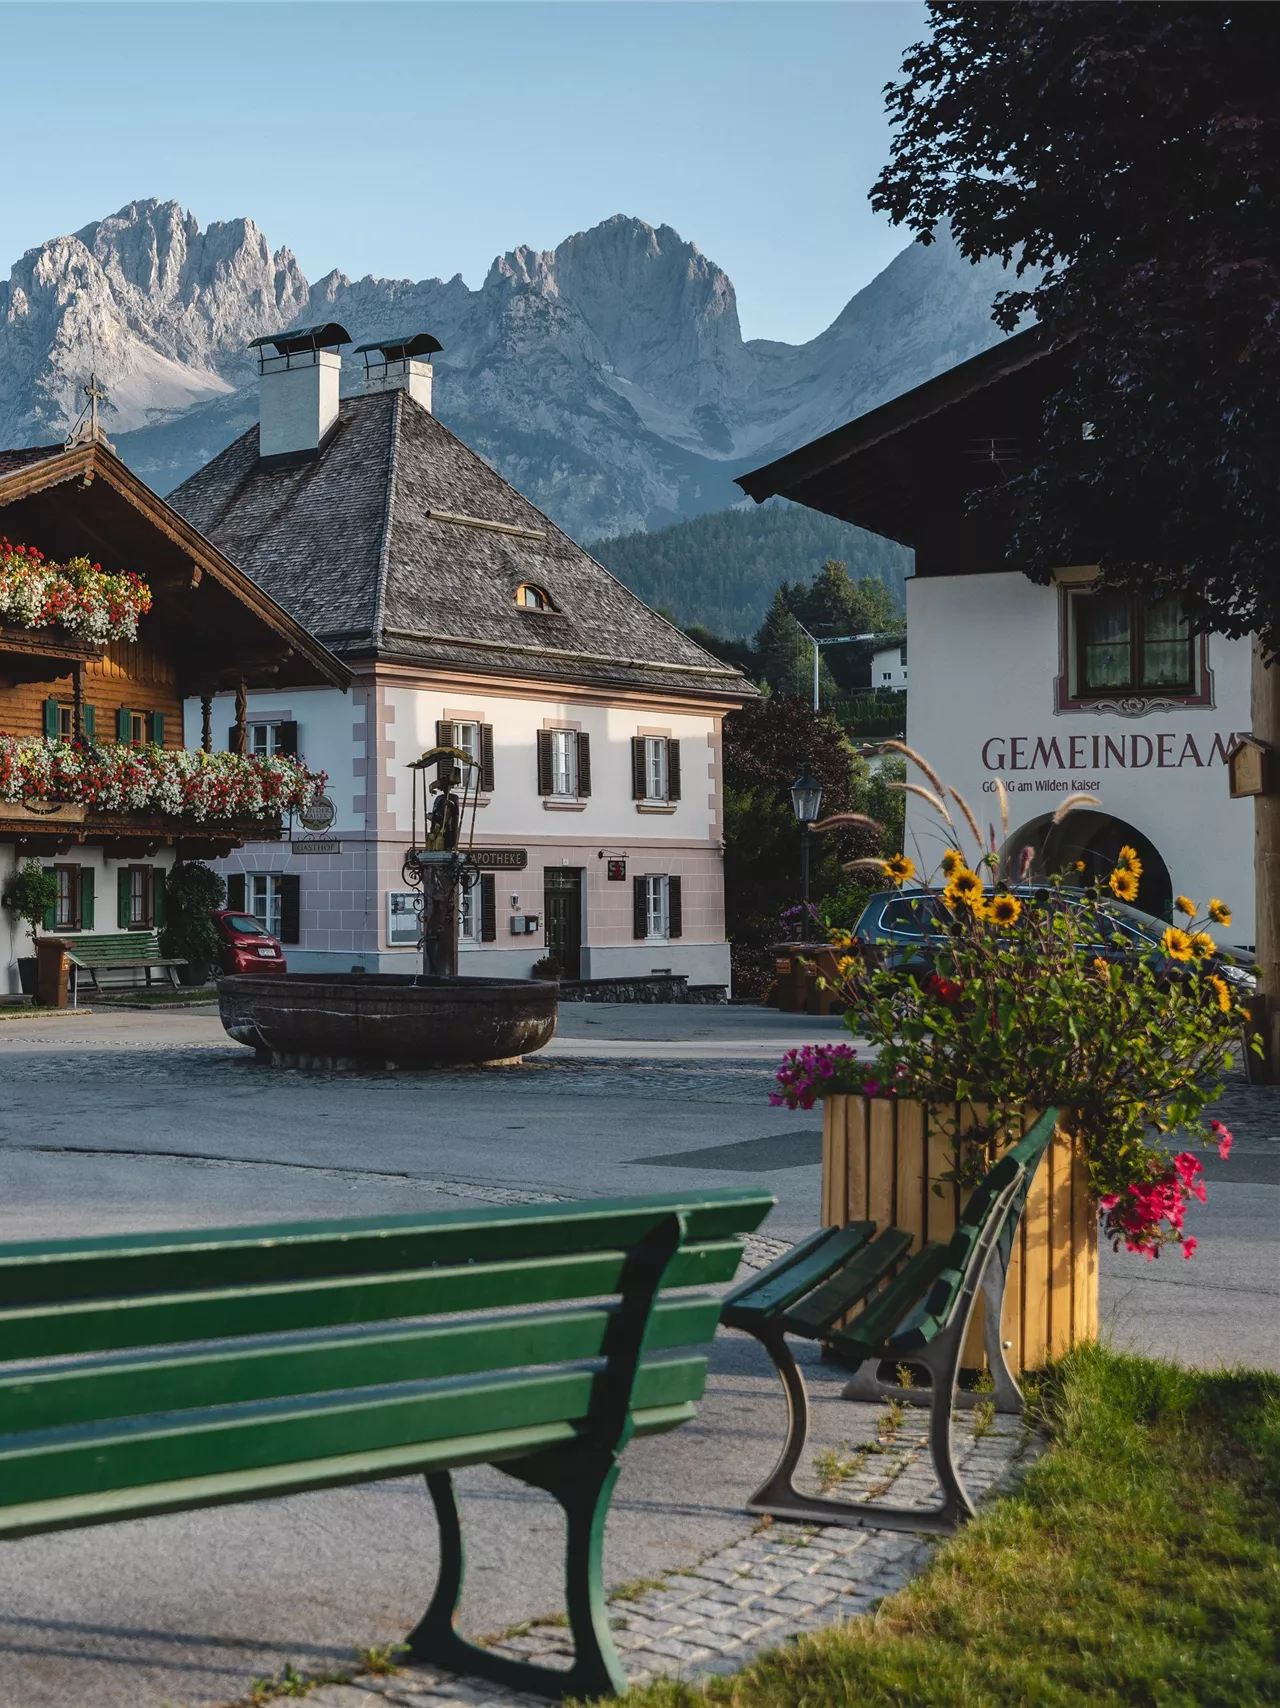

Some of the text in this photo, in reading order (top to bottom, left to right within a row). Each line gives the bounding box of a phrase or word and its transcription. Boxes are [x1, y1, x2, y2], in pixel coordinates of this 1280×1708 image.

[982, 779, 1101, 793] GONG am Wilden Kaiser
[297, 843, 335, 851] GASTHOF
[471, 853, 521, 864] APOTHEKE
